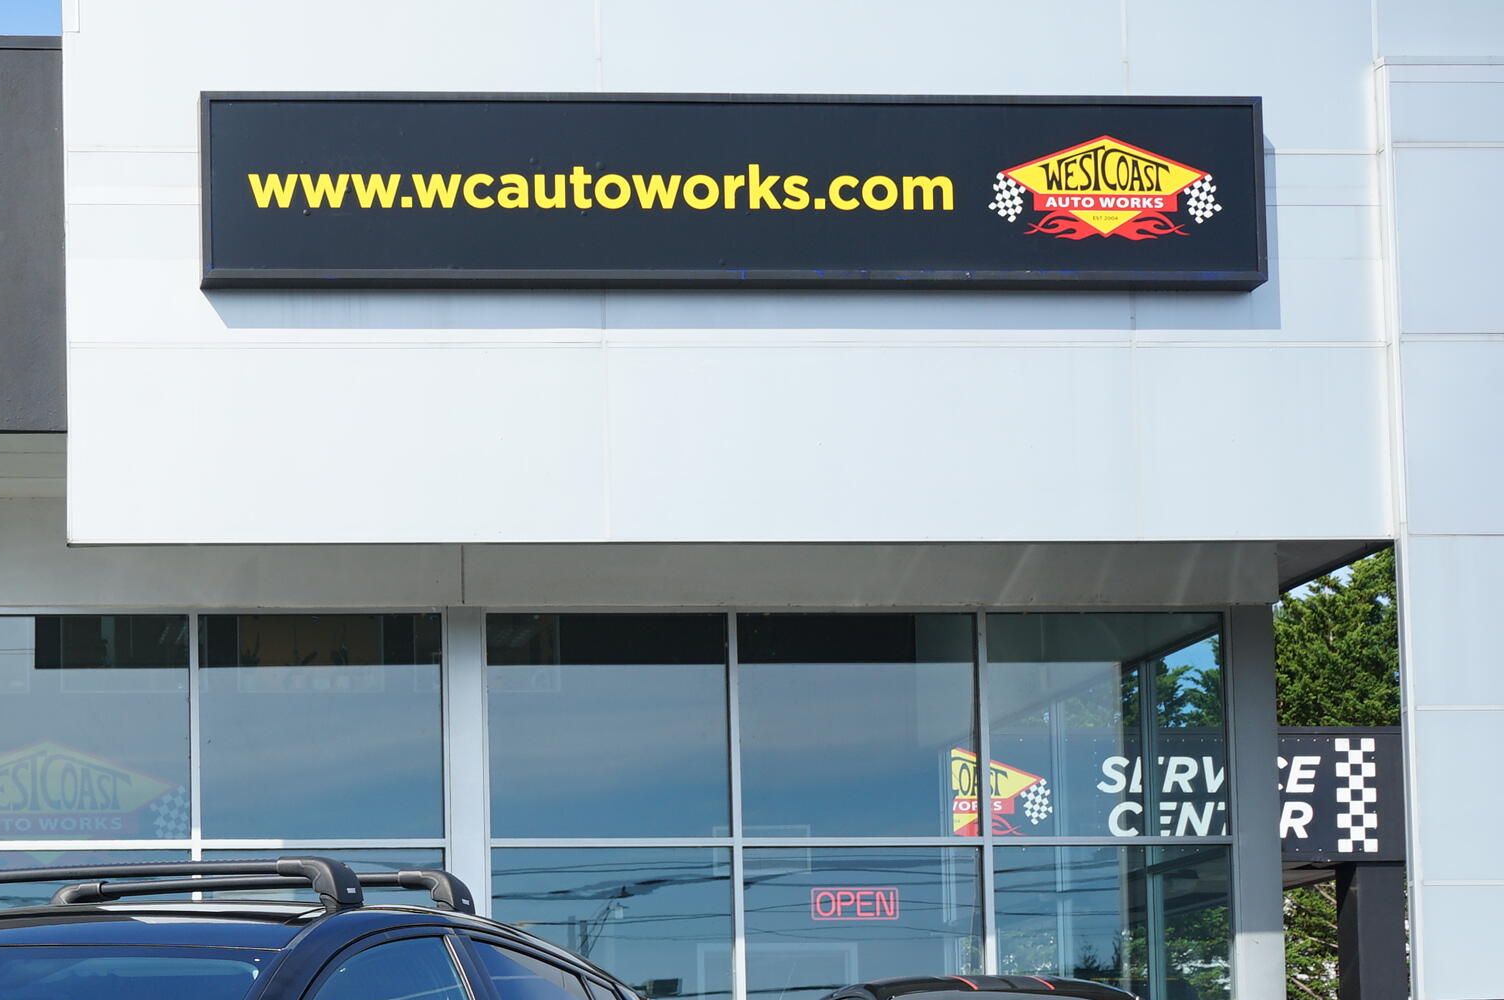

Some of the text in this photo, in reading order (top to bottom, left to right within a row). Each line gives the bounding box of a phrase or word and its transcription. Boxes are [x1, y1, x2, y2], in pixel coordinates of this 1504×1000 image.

[248, 163, 954, 211] www.wcautoworks.com
[1045, 197, 1164, 209] AUTO WORKS
[1096, 756, 1321, 793] SRVE
[38, 817, 122, 831] WORKS
[1108, 801, 1313, 838] CNR
[816, 891, 895, 917] OPEN
